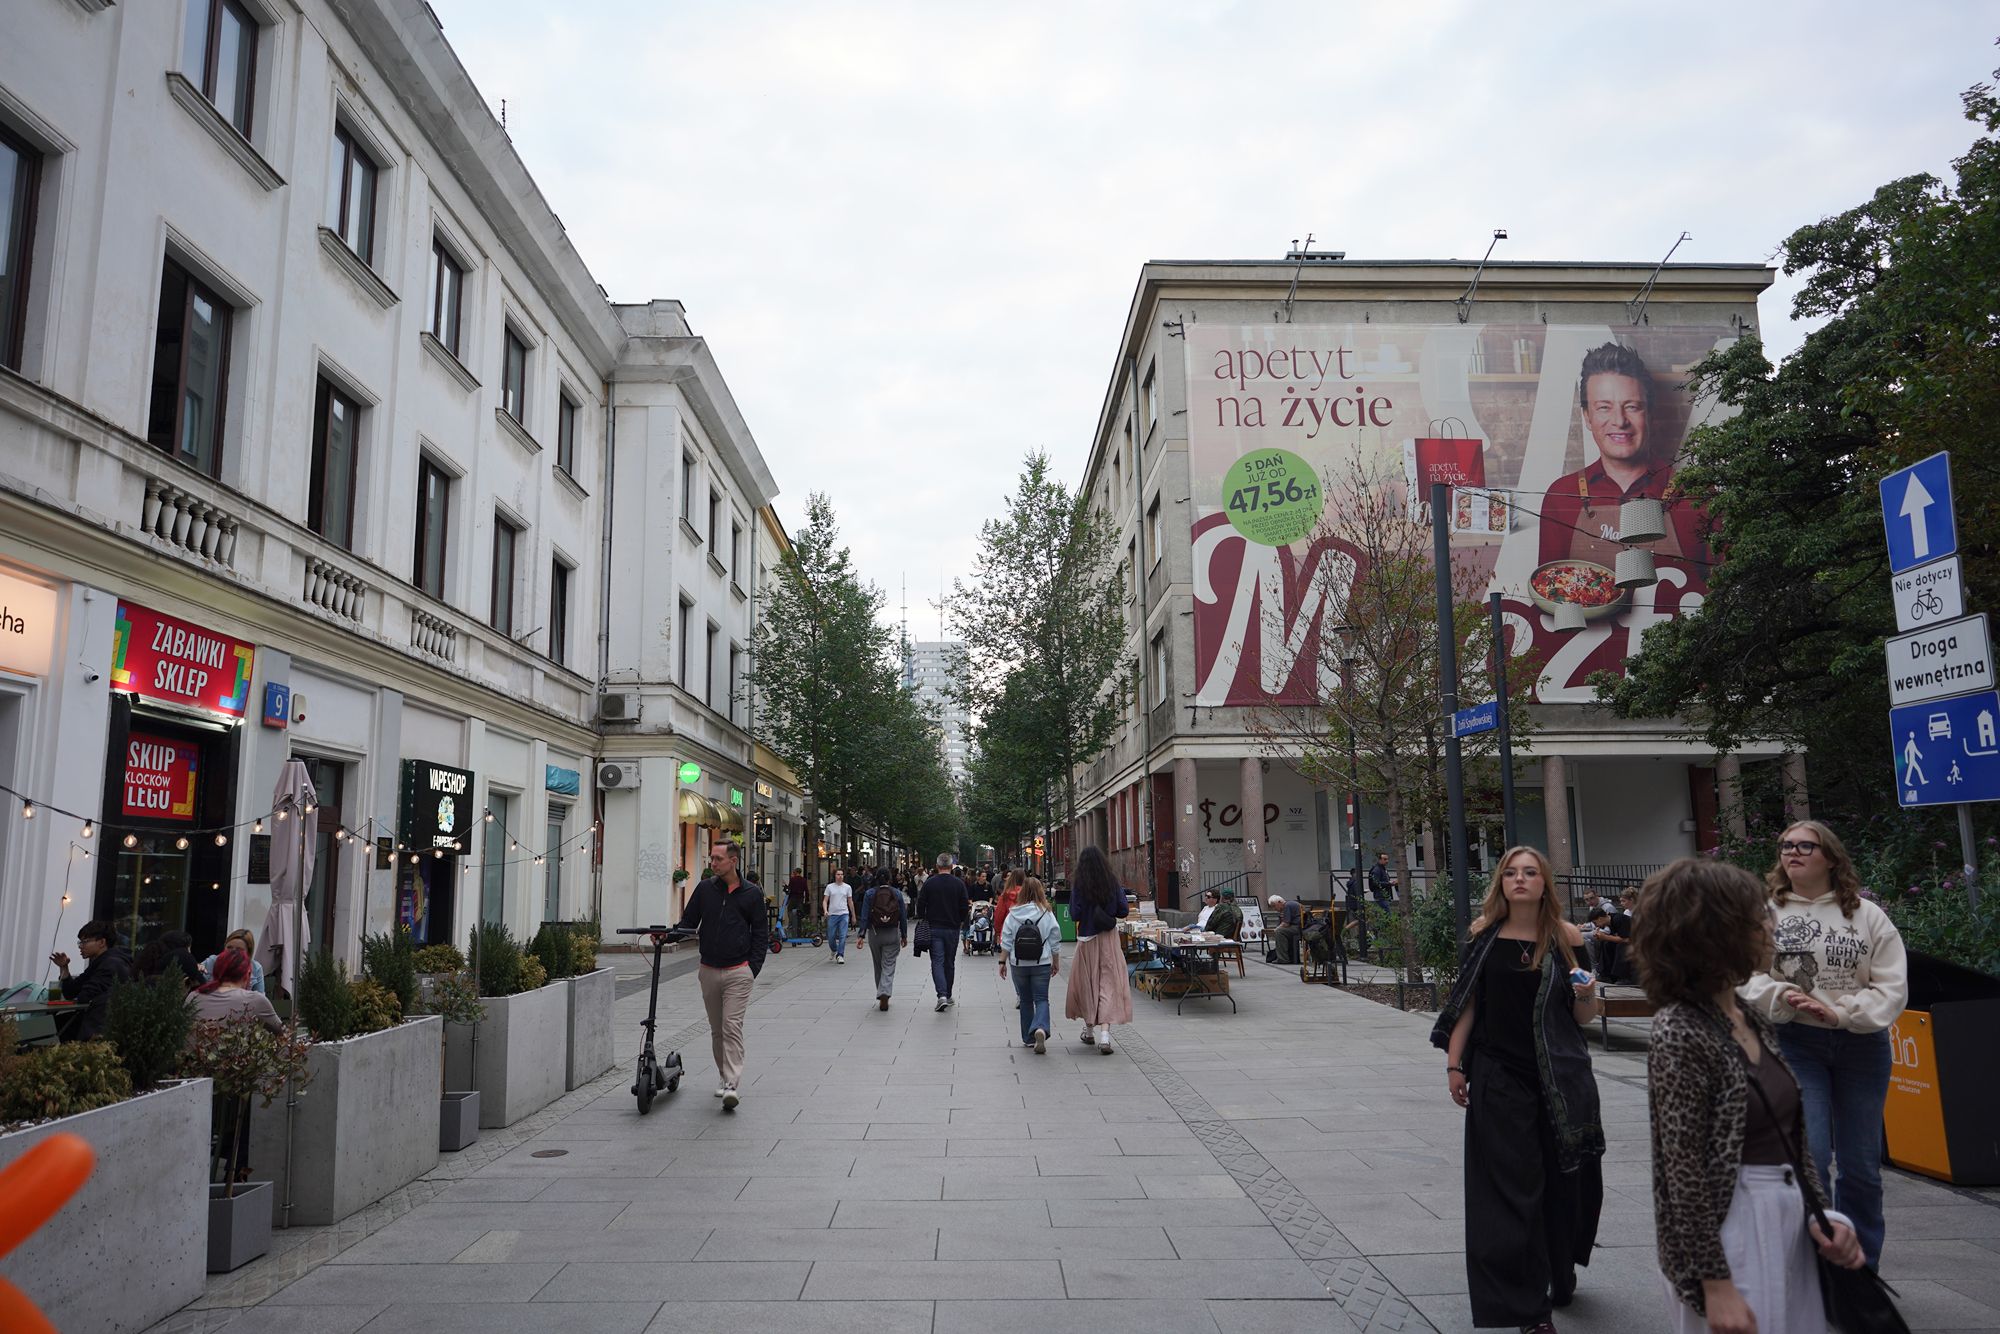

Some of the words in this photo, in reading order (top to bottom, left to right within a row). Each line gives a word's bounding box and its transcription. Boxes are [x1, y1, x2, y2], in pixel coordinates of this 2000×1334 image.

[1214, 344, 1355, 391] apetyt
[1216, 394, 1265, 427] na
[1280, 386, 1393, 439] życie
[1245, 462, 1252, 473] 5
[1255, 453, 1283, 470] DAŃ
[1428, 462, 1458, 474] apetyt
[1247, 469, 1267, 484] JUŻ
[1269, 467, 1287, 478] OD
[1895, 578, 1912, 593] Nie
[1915, 567, 1953, 586] dotyczy
[151, 621, 226, 669] ZABAWKI
[1910, 635, 1957, 659] Droga
[154, 659, 208, 698] SKLEP
[1894, 660, 1985, 691] wewnętrzna
[275, 694, 283, 717] 9
[128, 741, 176, 772] SKUP
[124, 770, 171, 788] KLOCKÓW
[429, 768, 467, 795] VAPESHOP
[1824, 934, 1869, 955] ALWAYS
[1825, 945, 1860, 960] FIGHT
[1827, 956, 1859, 970] BACK
